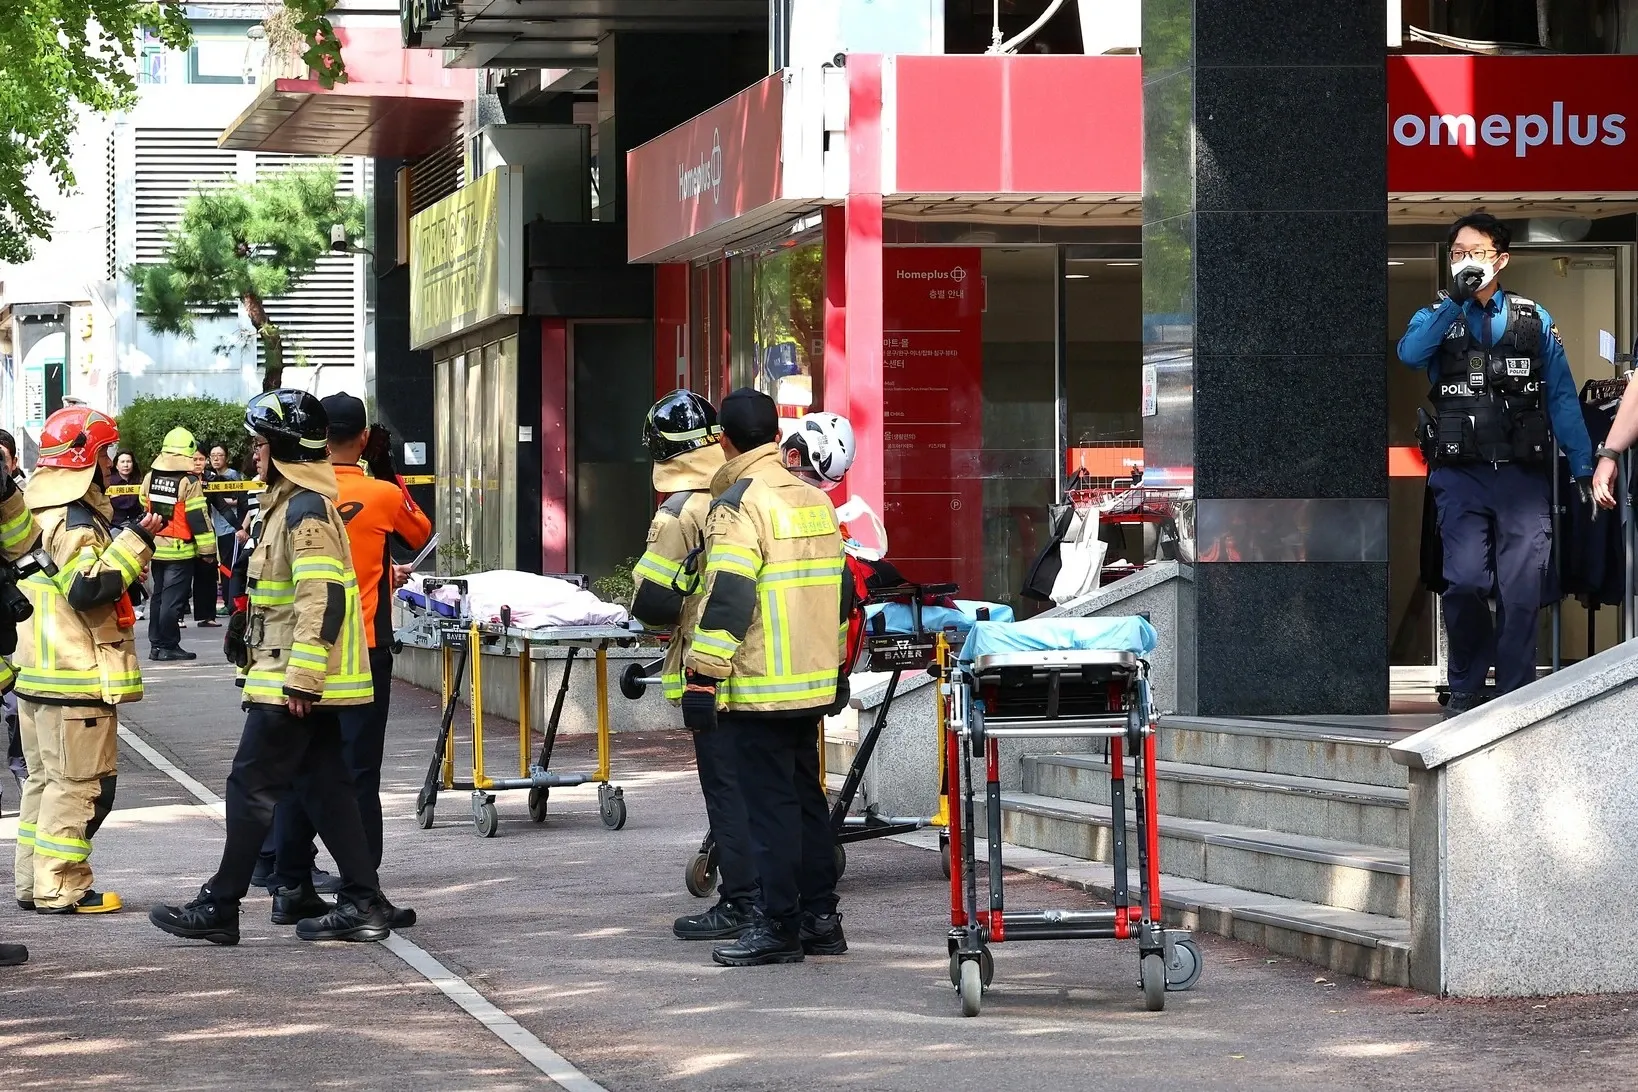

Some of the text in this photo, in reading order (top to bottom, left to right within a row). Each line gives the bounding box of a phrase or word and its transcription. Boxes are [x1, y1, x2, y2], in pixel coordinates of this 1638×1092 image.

[1387, 101, 1627, 158] omeplus
[678, 151, 711, 204] Homeplus
[896, 269, 949, 281] Homeplus
[929, 289, 964, 299] 층별 안내
[884, 649, 923, 660] SAVER
